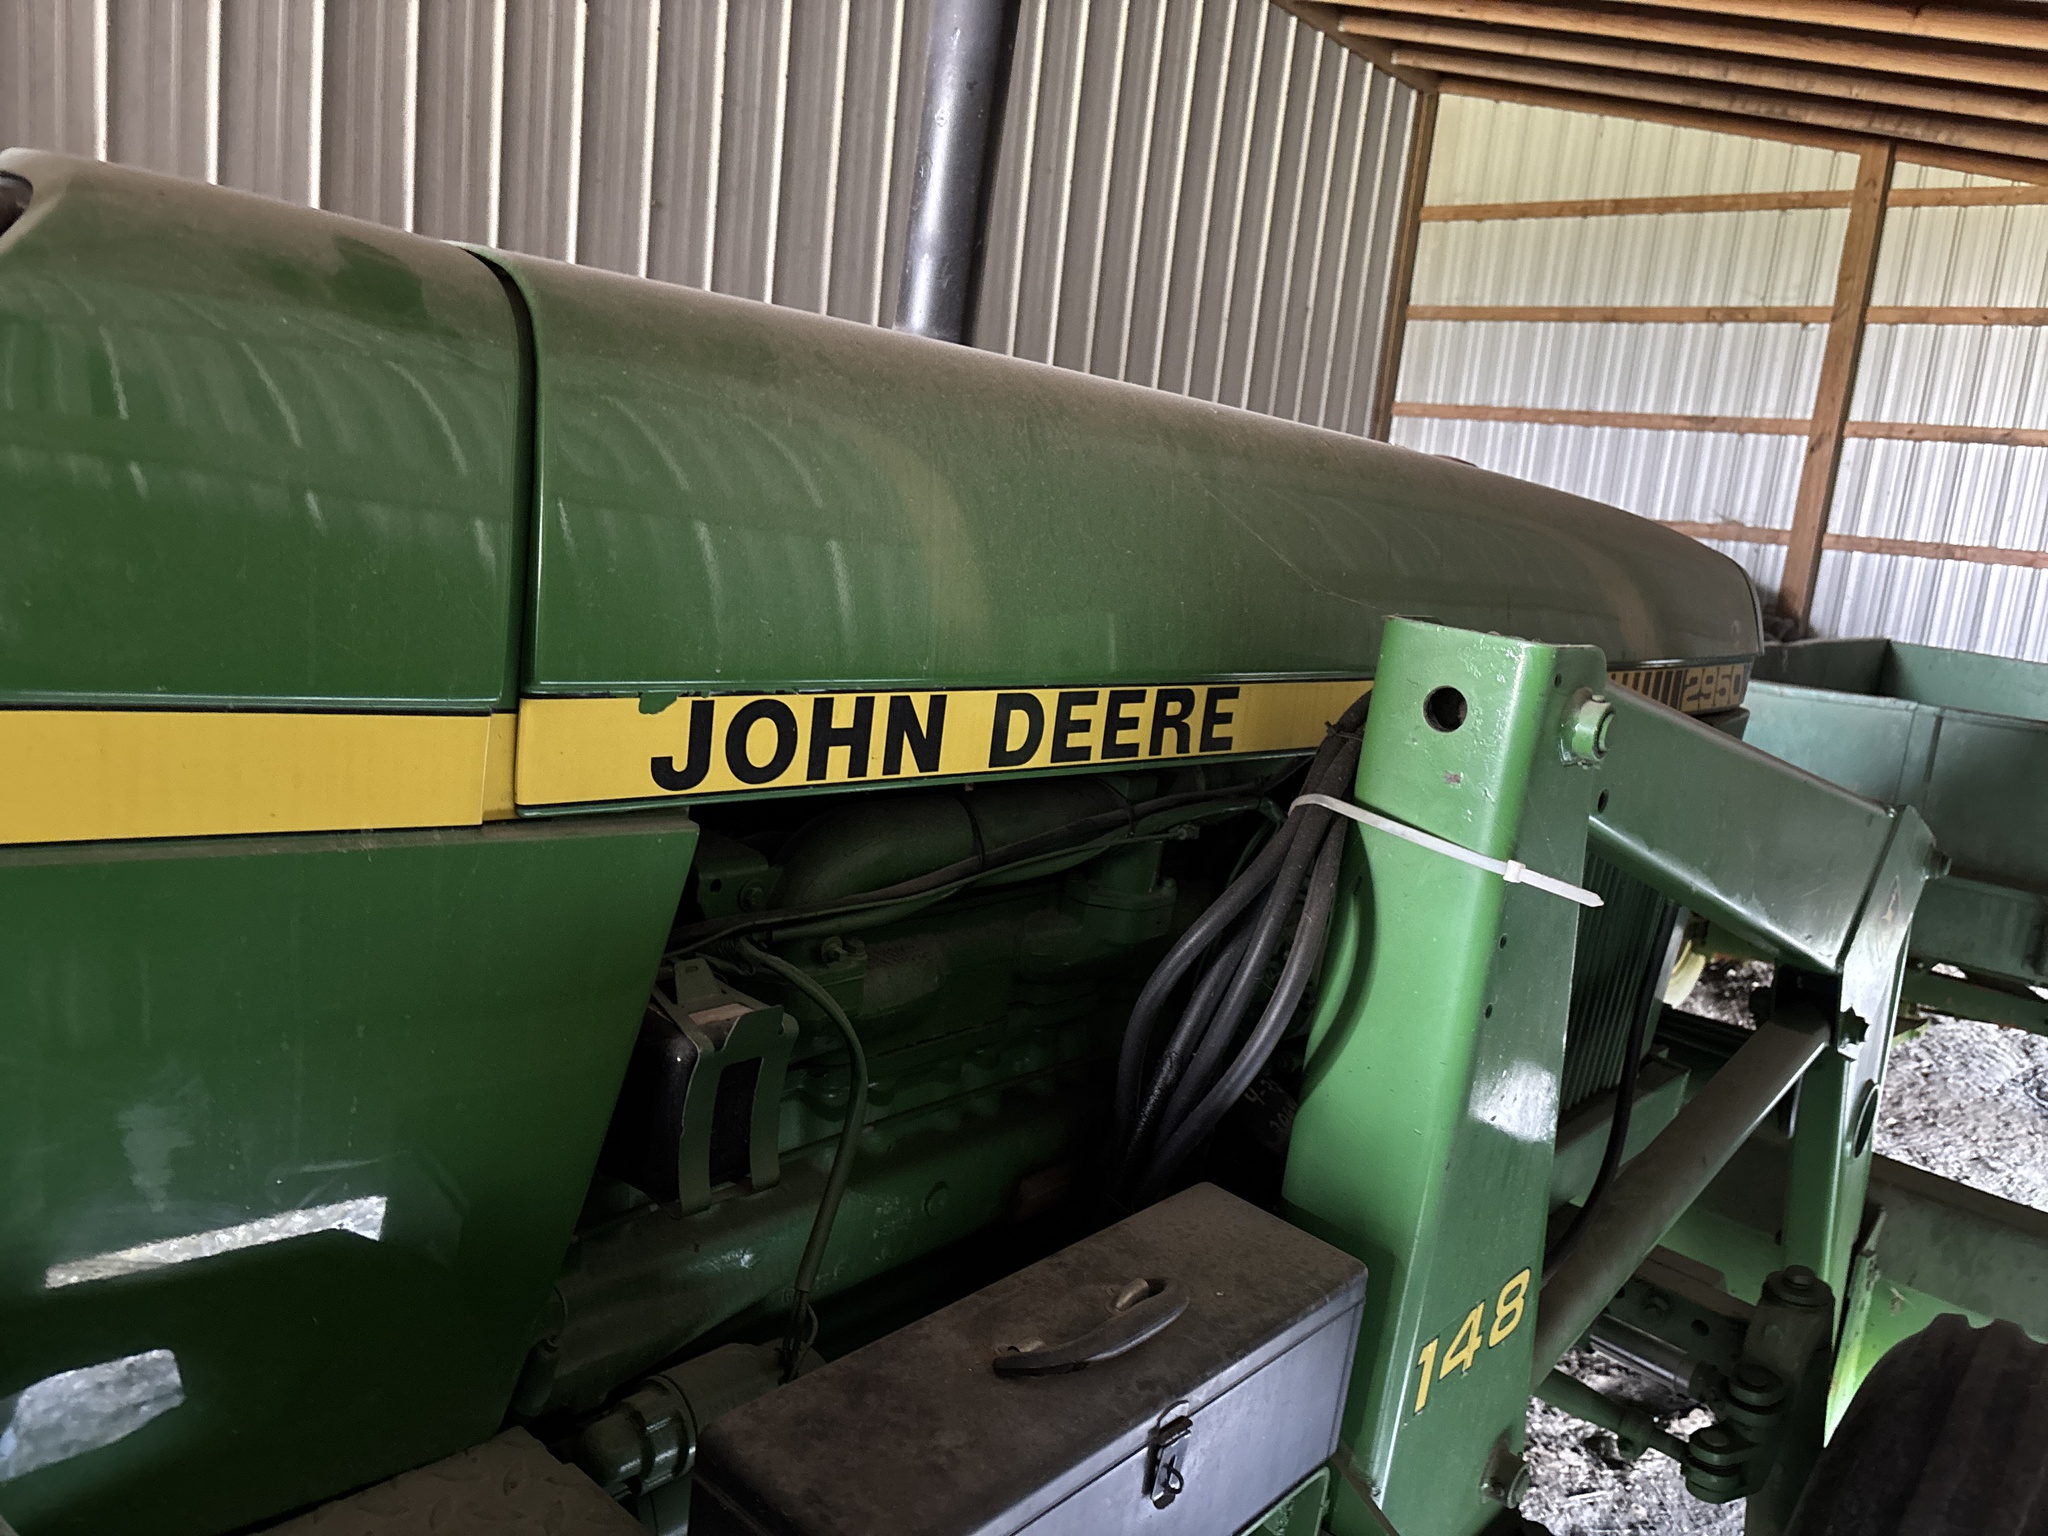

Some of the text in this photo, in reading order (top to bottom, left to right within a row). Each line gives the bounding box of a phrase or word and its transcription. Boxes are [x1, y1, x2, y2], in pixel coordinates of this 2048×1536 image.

[651, 686, 1240, 791] JOHN DEERE
[1682, 664, 1745, 712] 2950
[1413, 1266, 1531, 1416] 148
